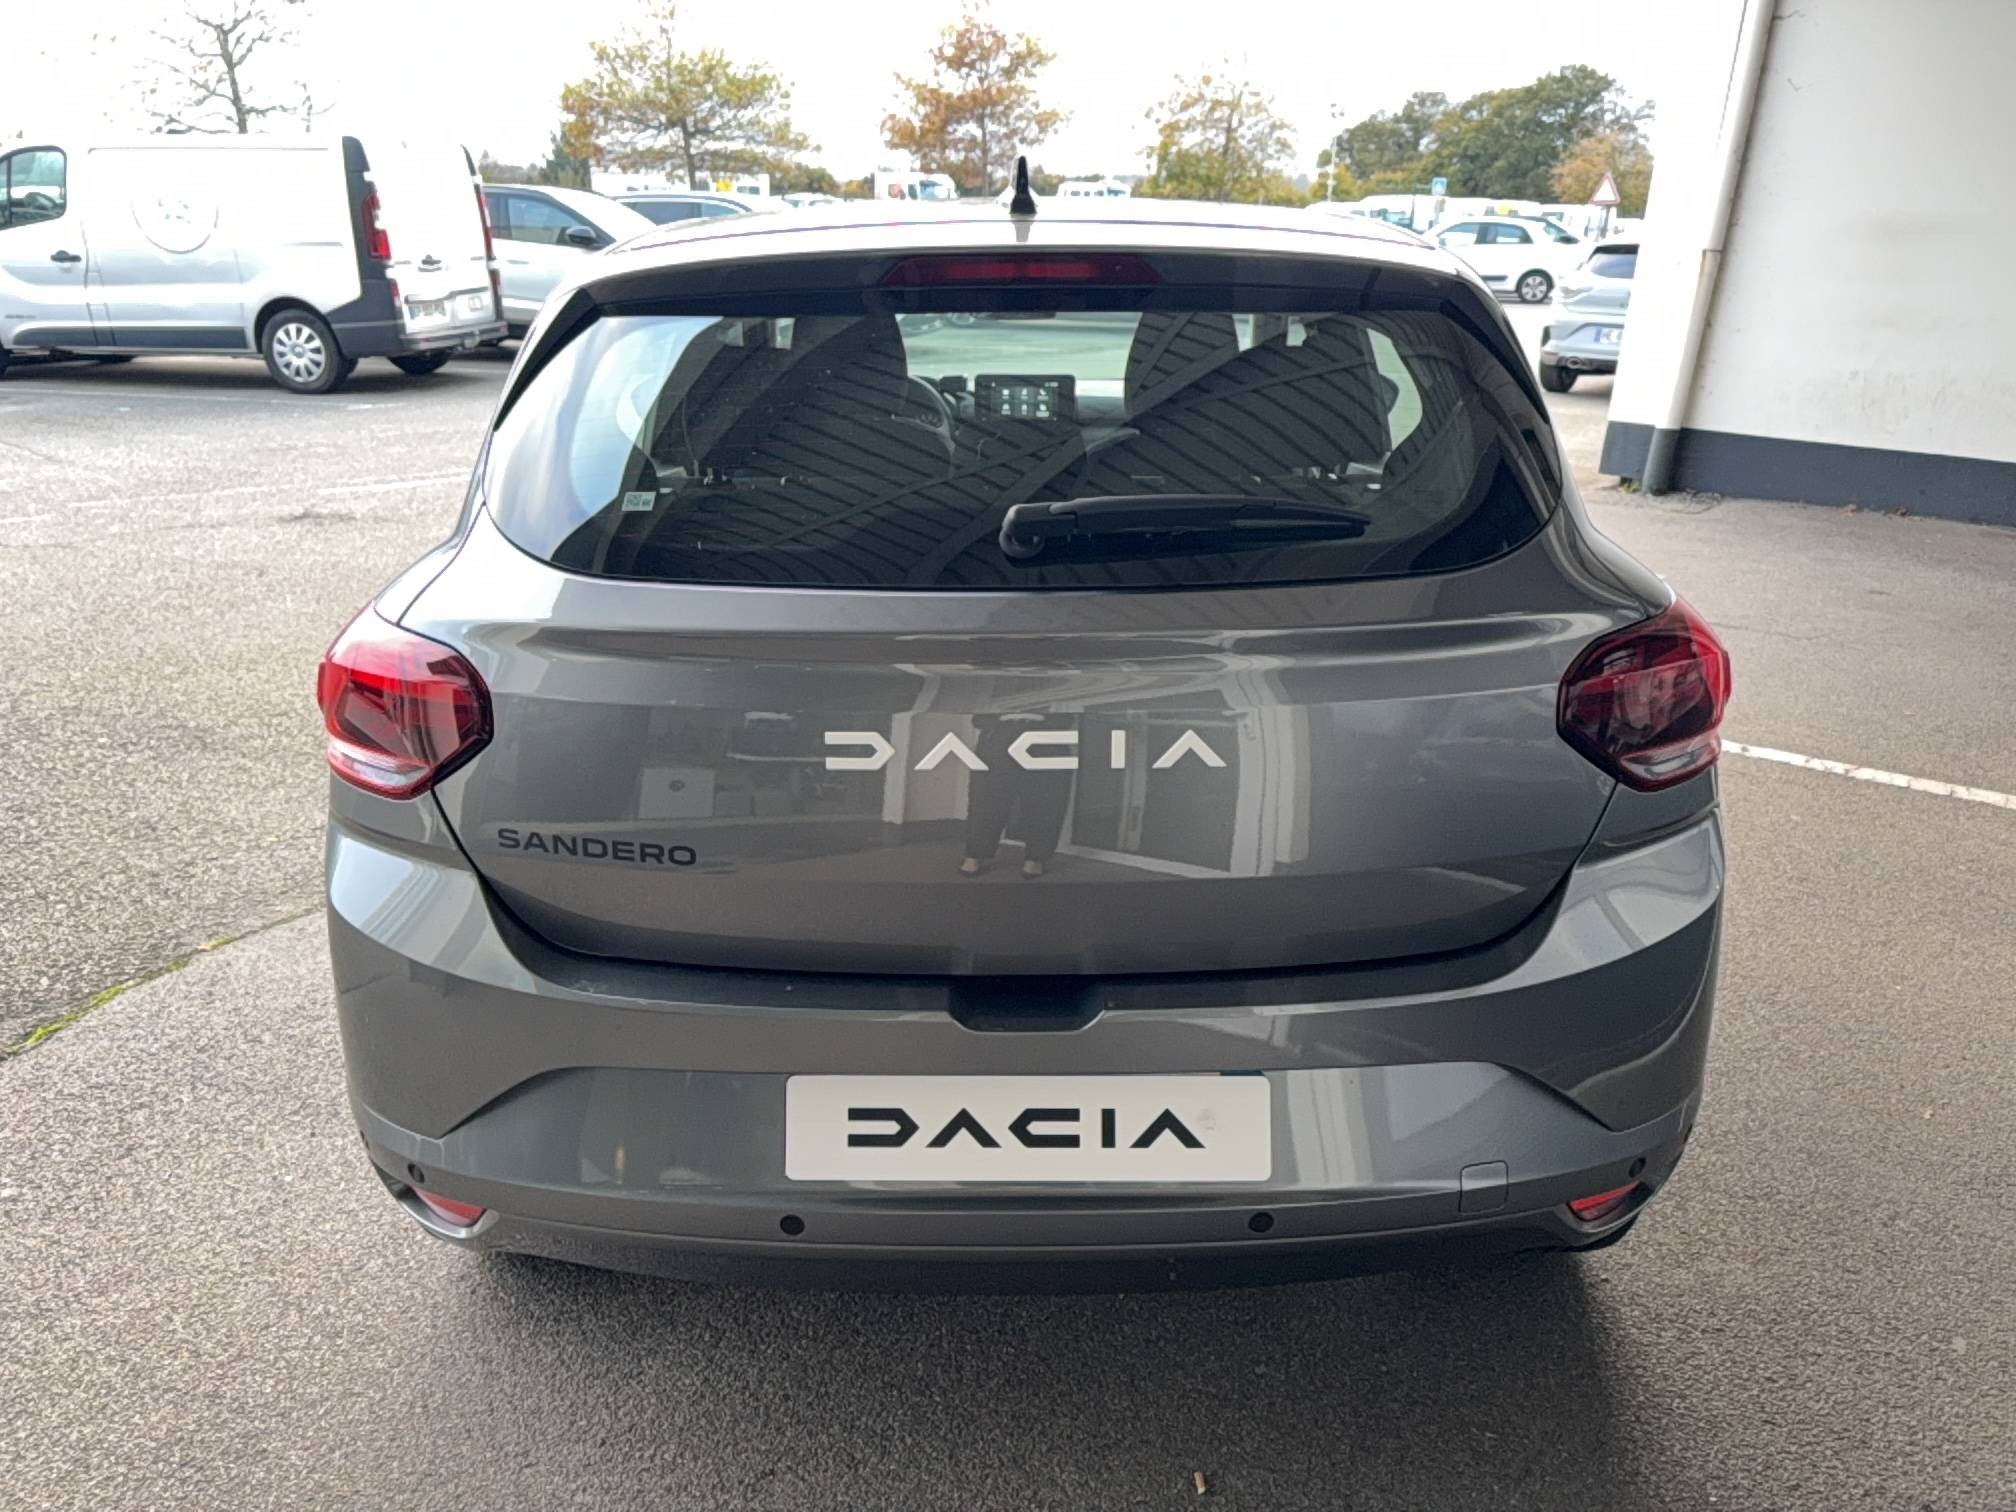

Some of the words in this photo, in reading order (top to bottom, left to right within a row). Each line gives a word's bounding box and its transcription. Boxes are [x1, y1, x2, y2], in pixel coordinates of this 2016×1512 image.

[824, 729, 1228, 771] DACIA
[497, 827, 697, 867] SANDERO
[847, 1107, 1207, 1149] DACIA
